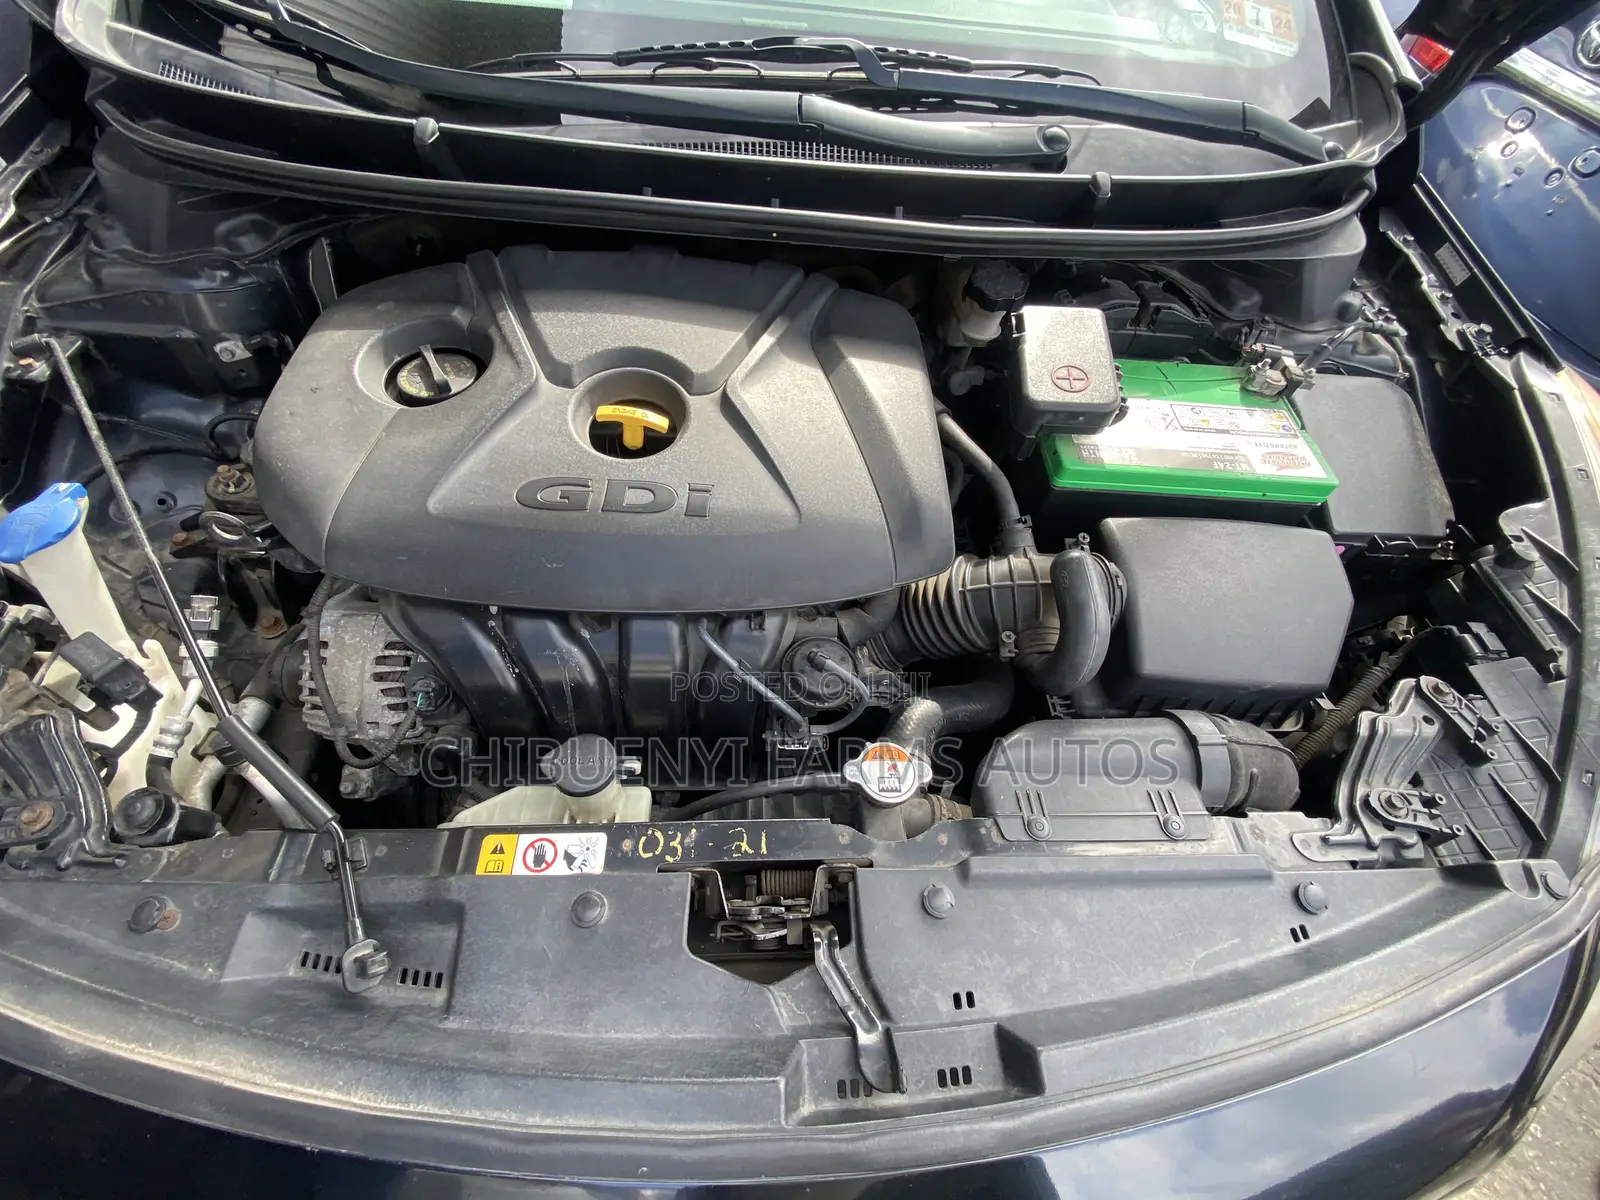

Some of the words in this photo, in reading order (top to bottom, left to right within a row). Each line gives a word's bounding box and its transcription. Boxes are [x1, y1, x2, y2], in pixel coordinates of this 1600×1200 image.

[1251, 6, 1260, 26] 7
[1275, 16, 1292, 32] 24
[1254, 441, 1298, 450] AUTOMOTIVE
[514, 477, 714, 518] GDi
